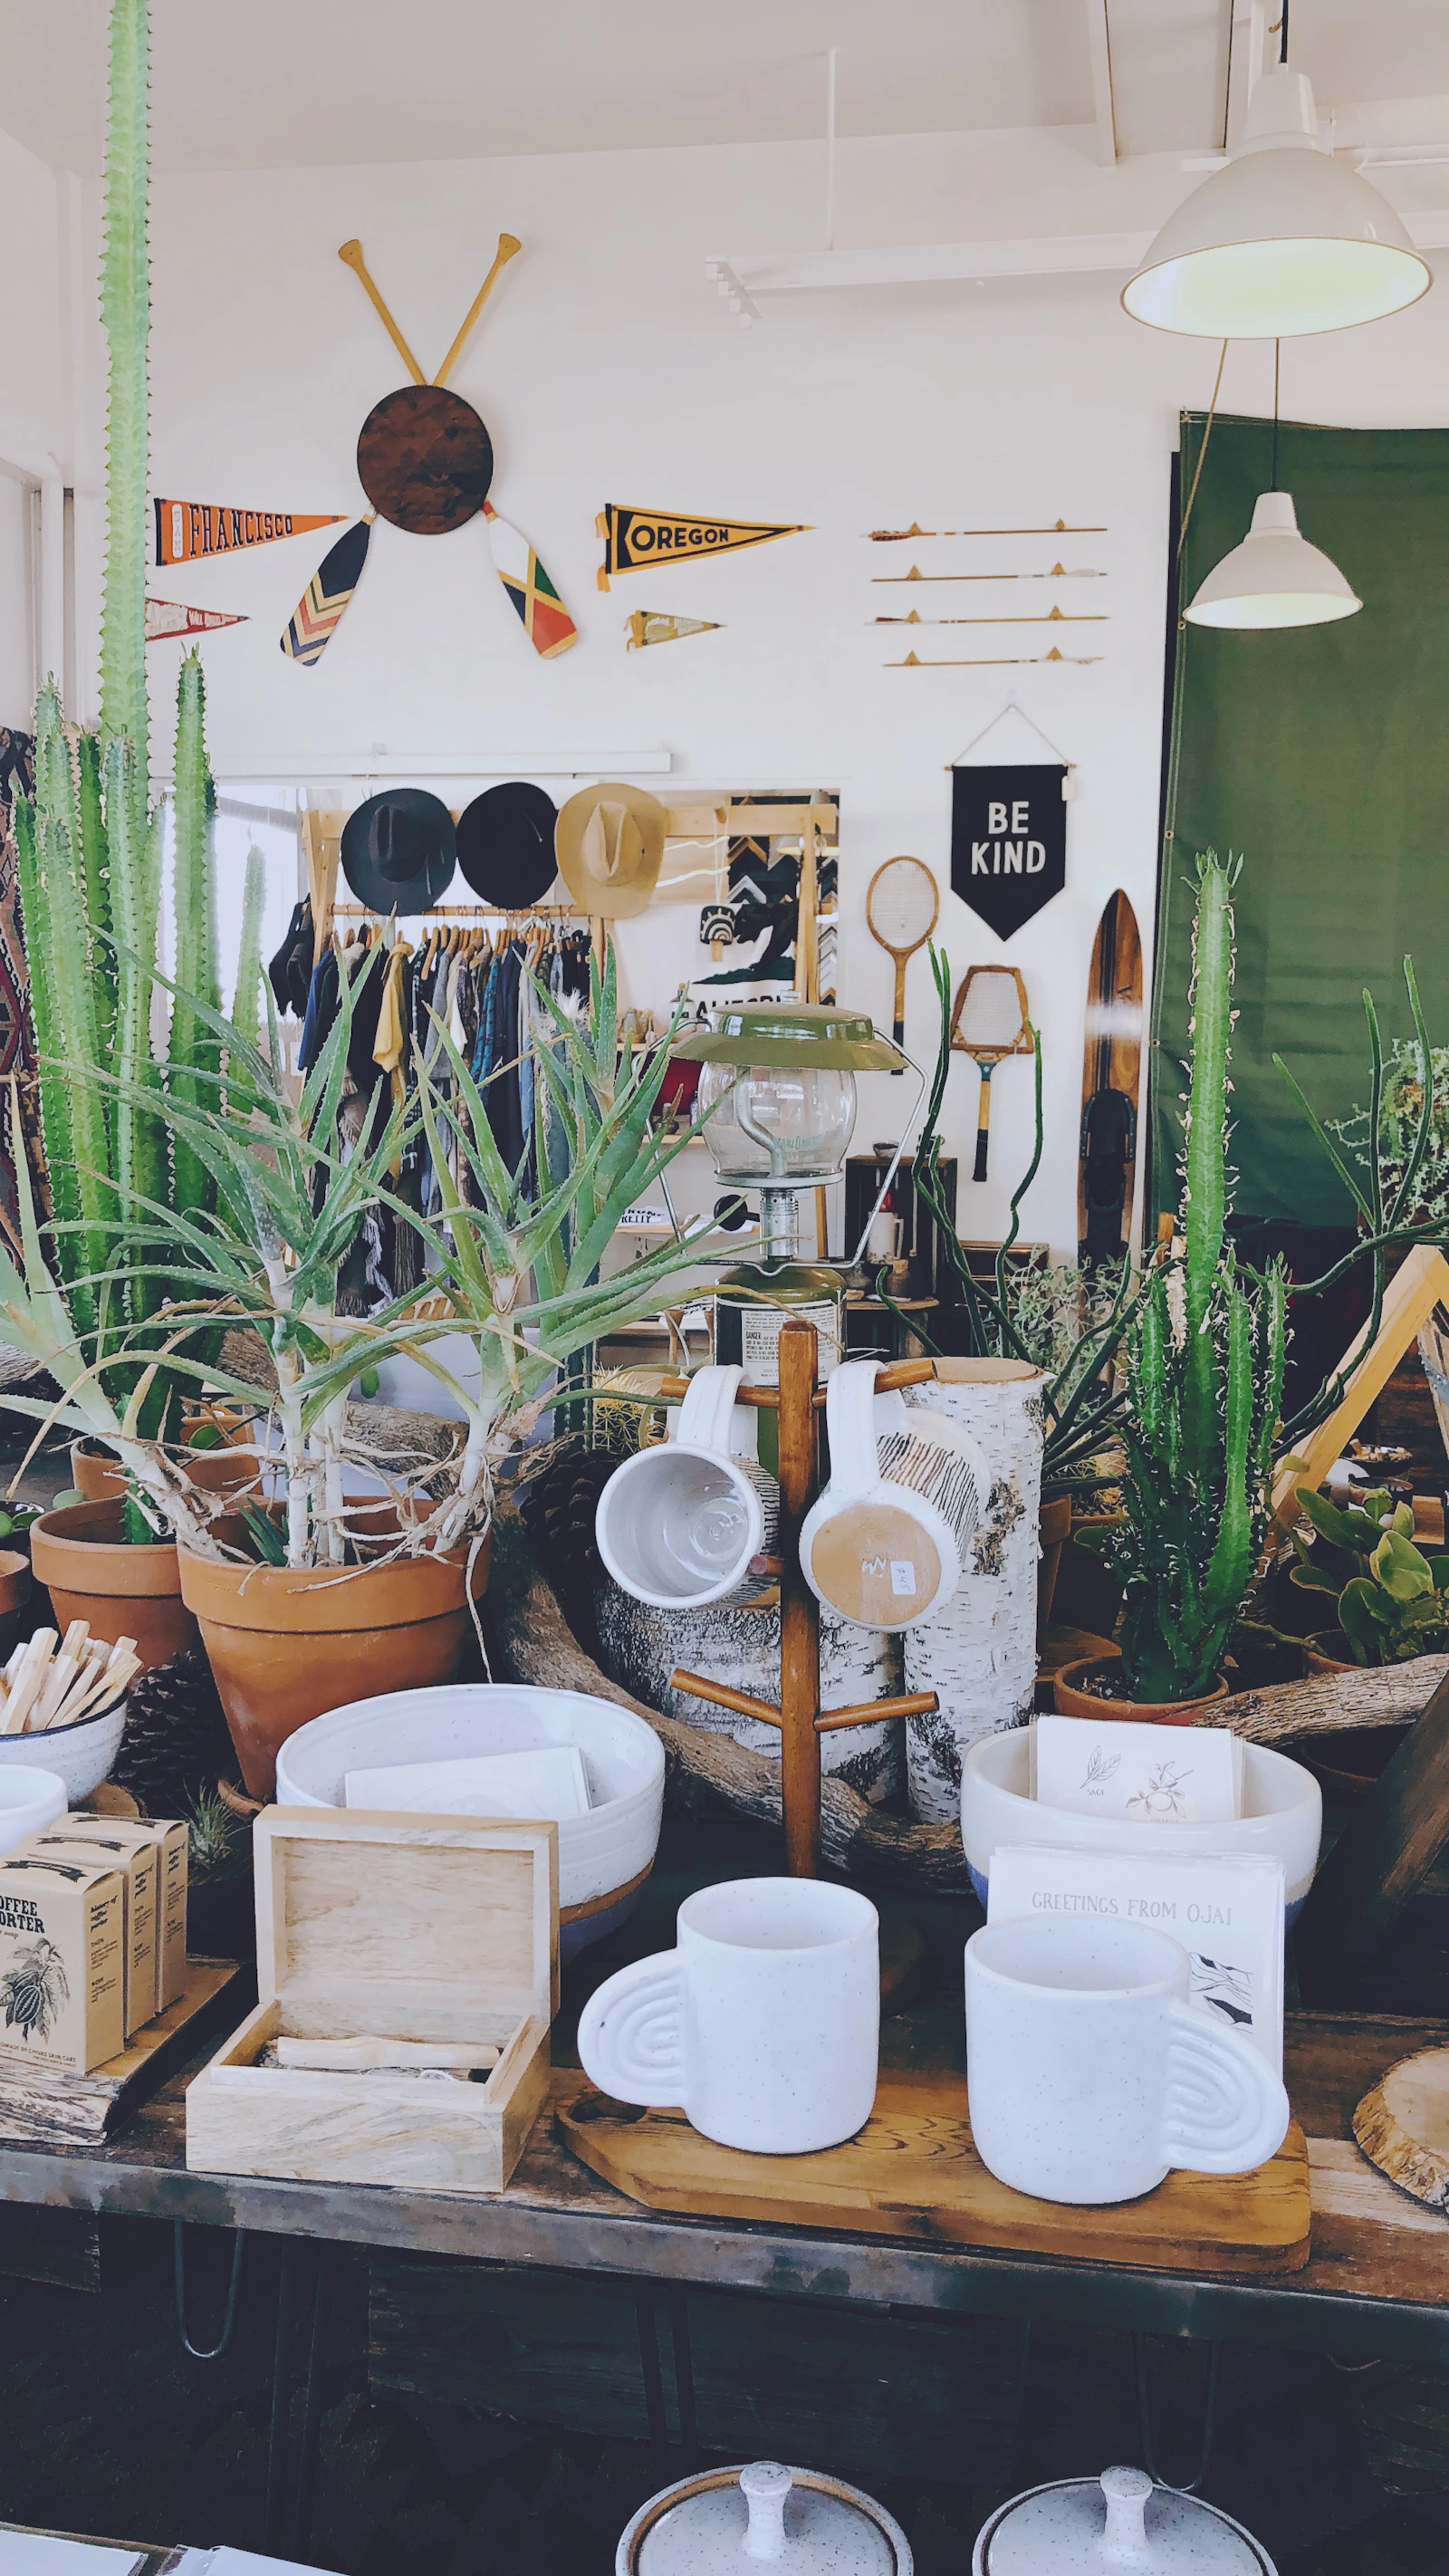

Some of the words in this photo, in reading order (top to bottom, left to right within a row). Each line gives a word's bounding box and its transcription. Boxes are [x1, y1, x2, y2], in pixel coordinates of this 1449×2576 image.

[187, 504, 293, 558] FRANCISCO
[631, 524, 729, 552] OREGON
[988, 801, 1030, 834] BE
[971, 841, 1046, 875] KIND
[1087, 1788, 1106, 1796] SAGE
[1032, 1891, 1119, 1915] GREETINGS
[1128, 1898, 1177, 1919] FROM
[1186, 1903, 1233, 1926] OJAI
